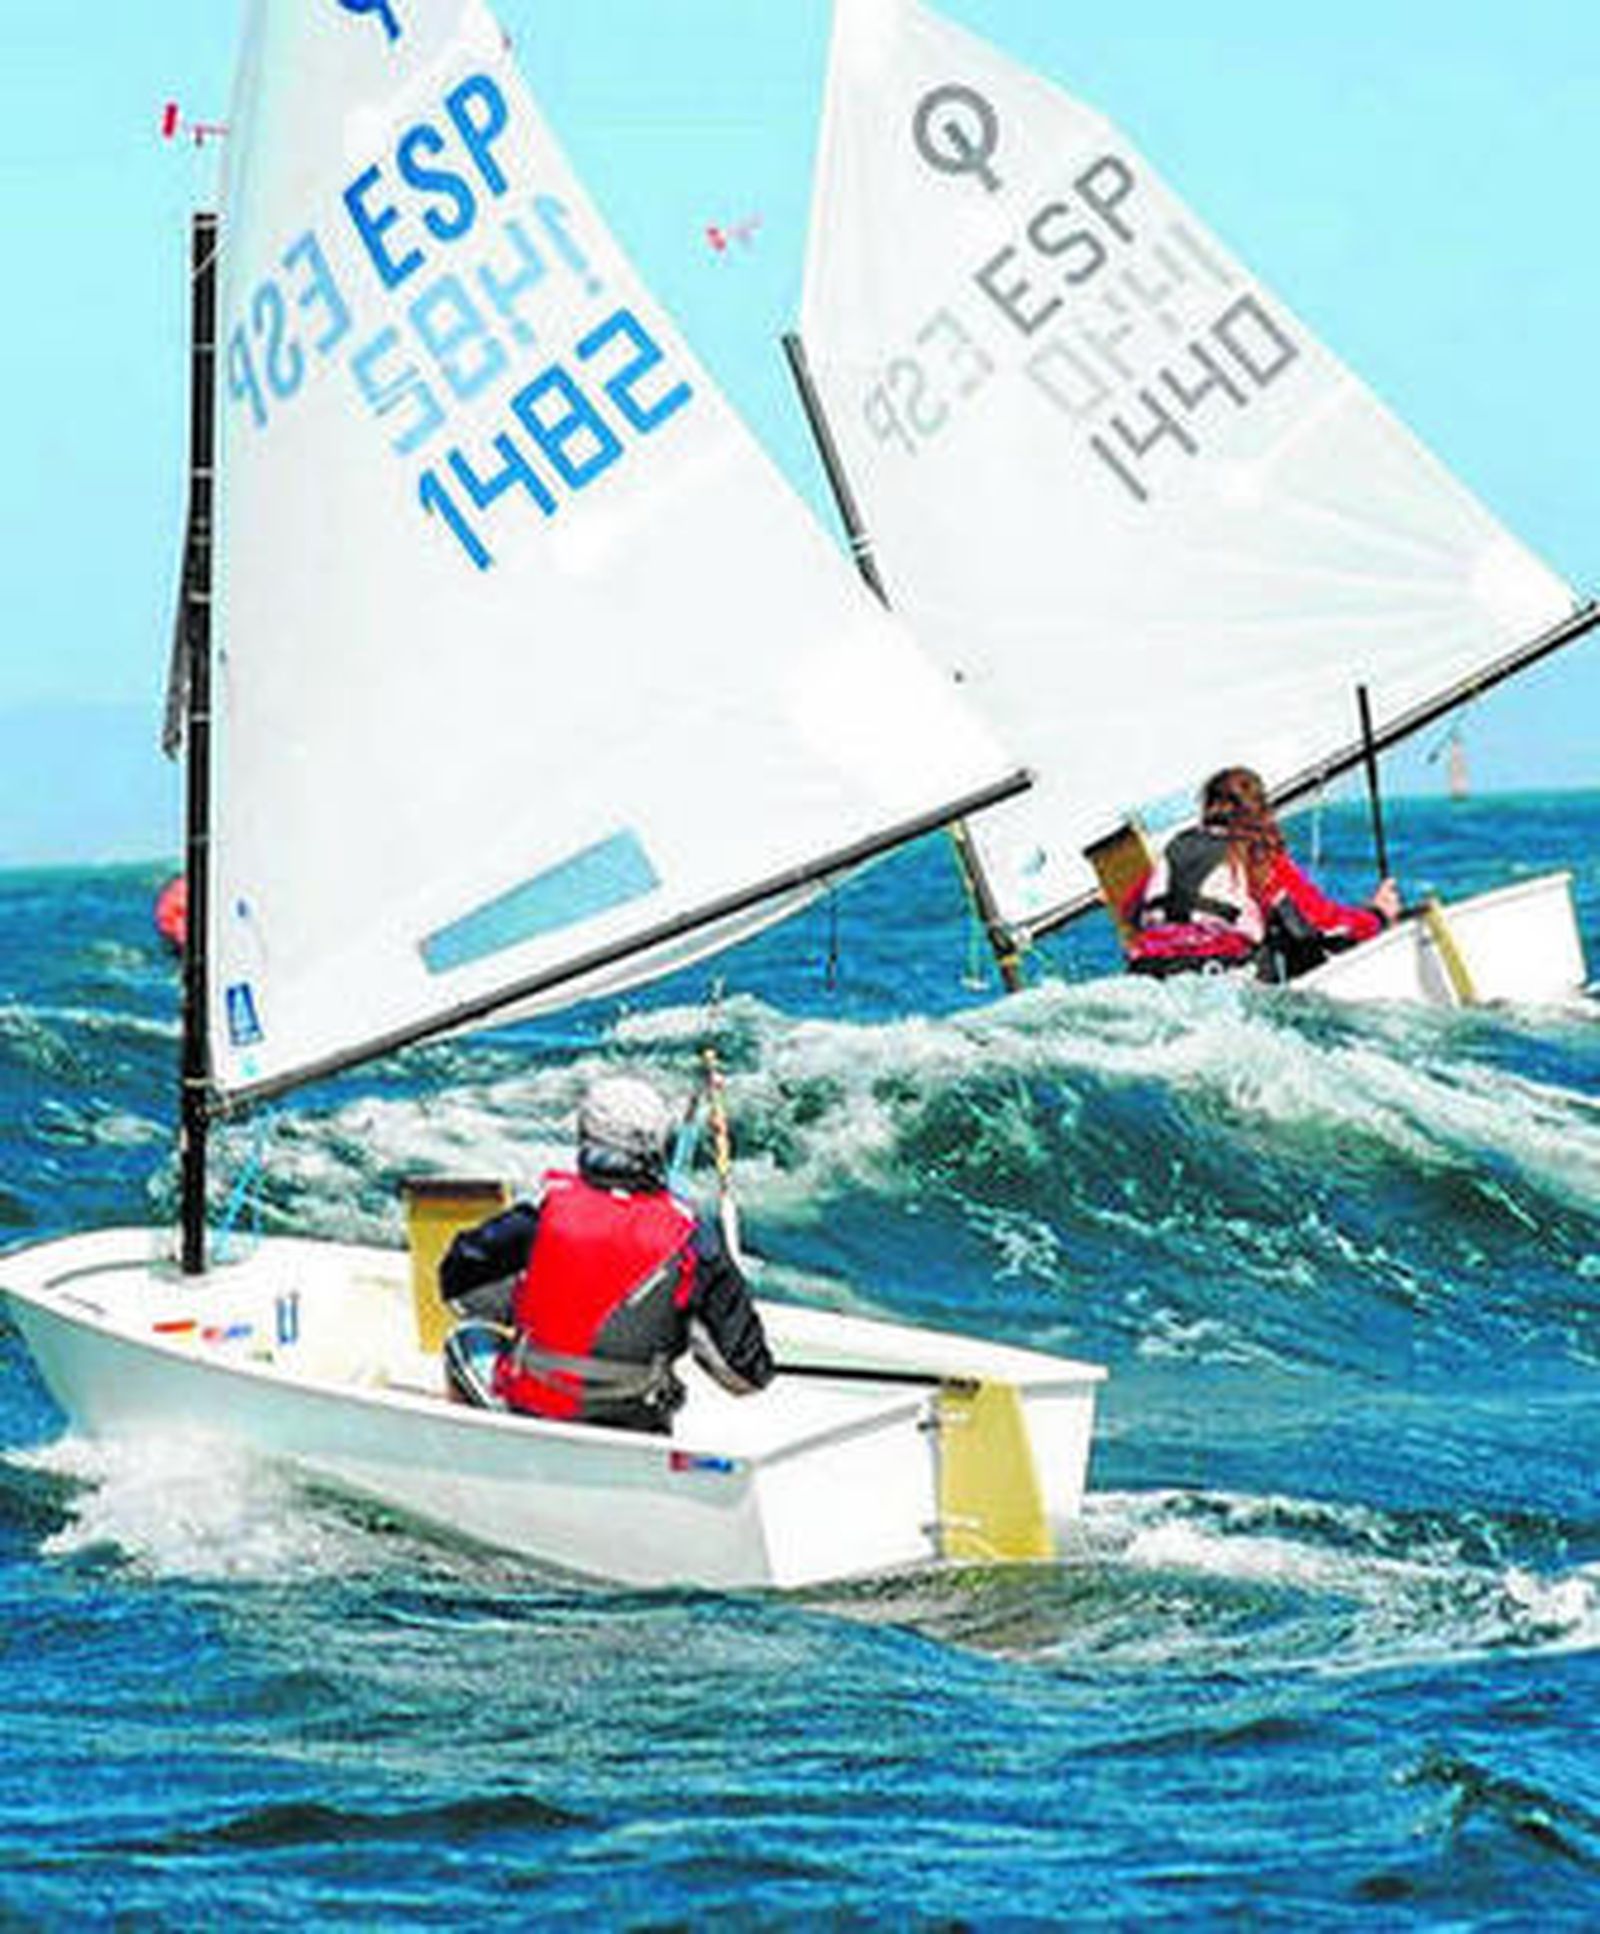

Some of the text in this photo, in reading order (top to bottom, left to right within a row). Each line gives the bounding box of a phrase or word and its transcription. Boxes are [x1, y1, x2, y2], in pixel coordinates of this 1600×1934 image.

[343, 73, 509, 290] ESP
[973, 154, 1135, 337] ESP
[419, 308, 693, 571] 1482
[1090, 292, 1299, 502] 1440
